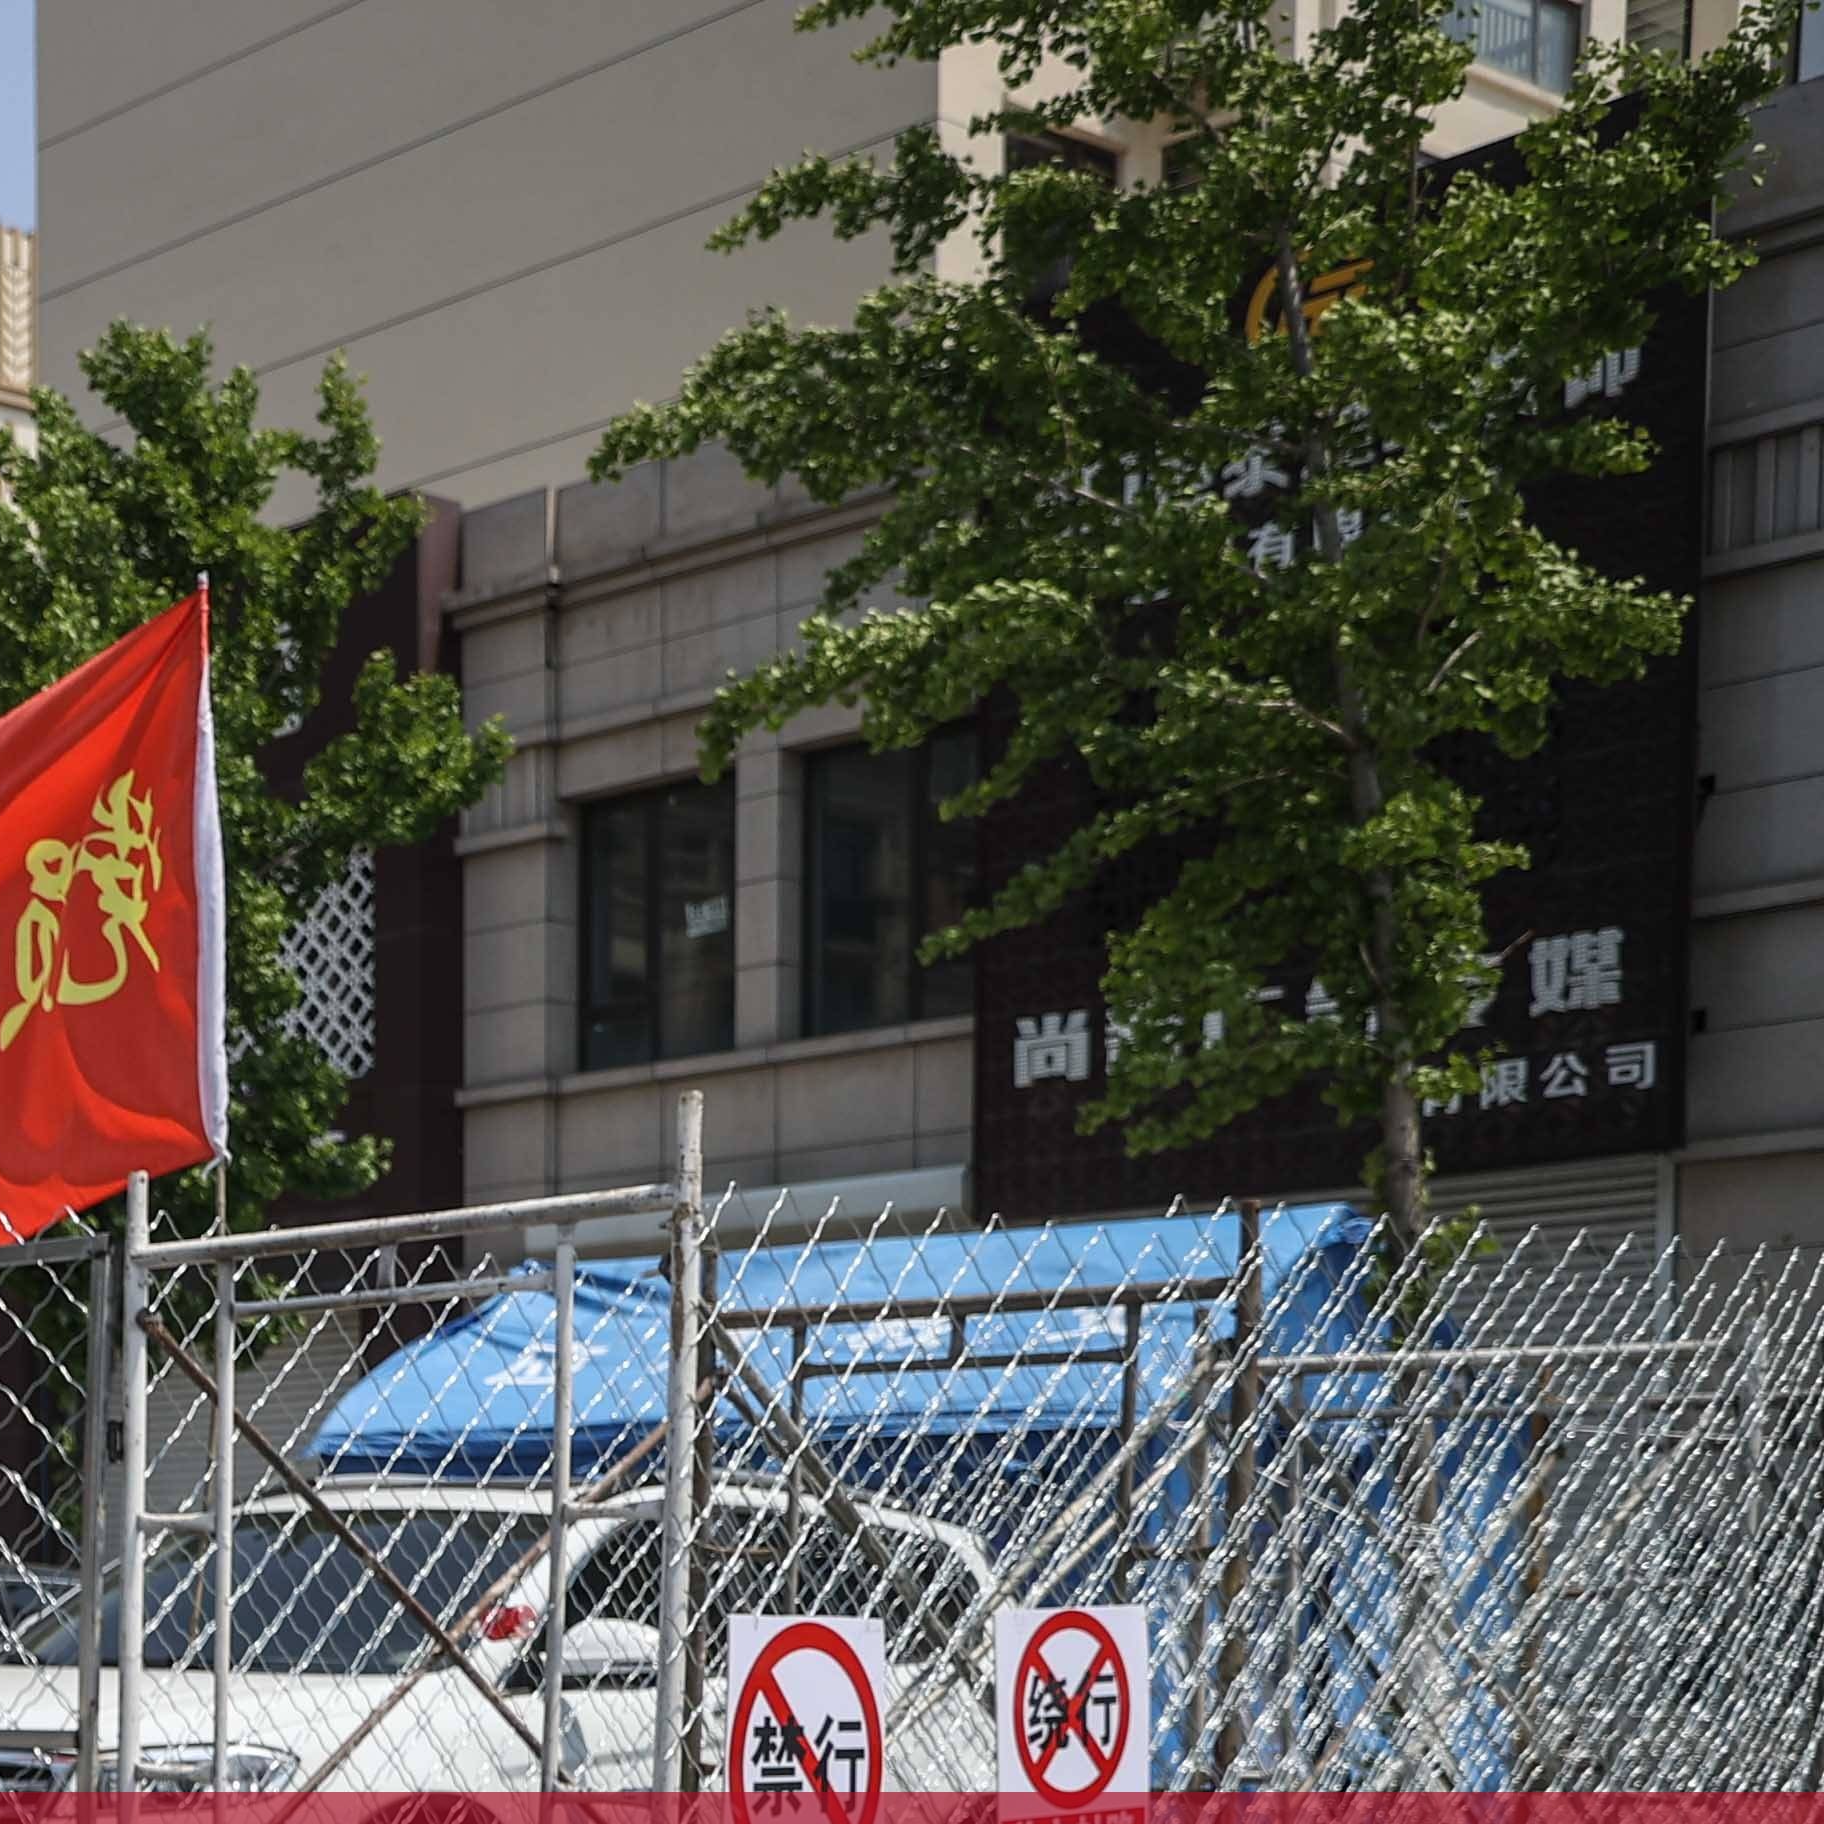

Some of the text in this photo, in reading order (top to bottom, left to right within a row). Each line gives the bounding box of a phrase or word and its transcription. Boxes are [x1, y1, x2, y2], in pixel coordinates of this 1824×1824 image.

[1422, 1040, 1656, 1117] 限公司
[752, 1714, 865, 1818] 禁行
